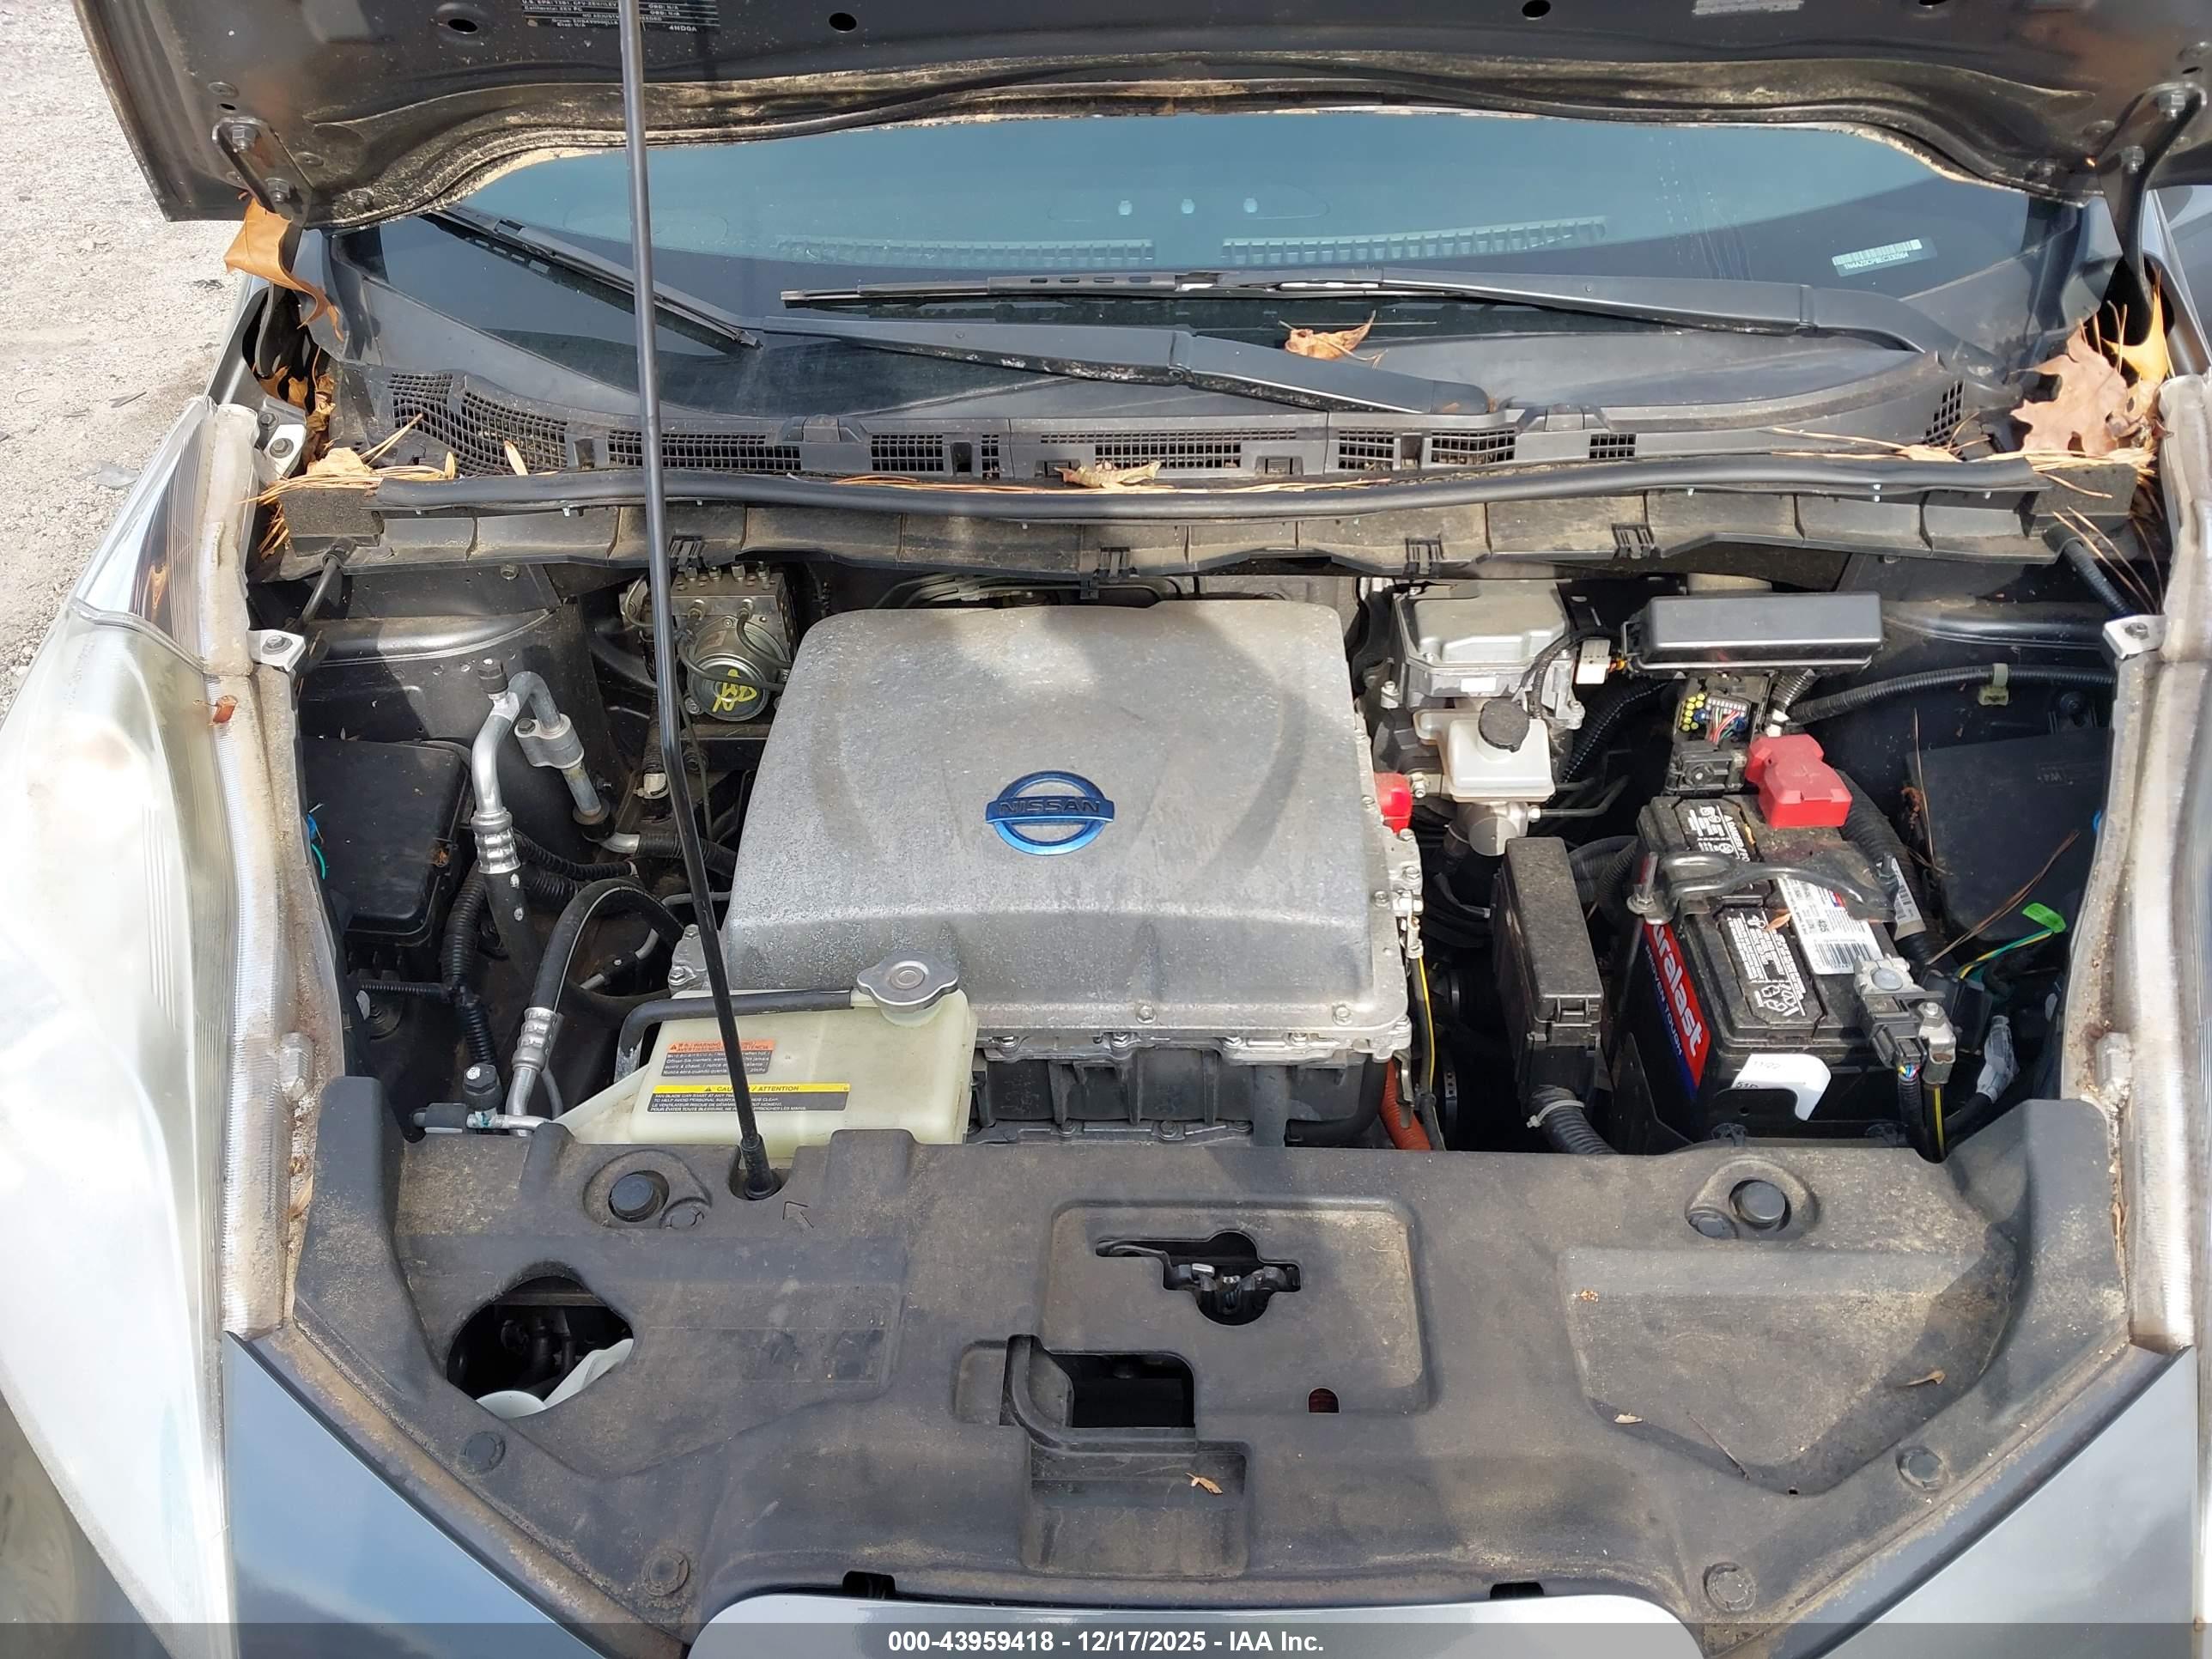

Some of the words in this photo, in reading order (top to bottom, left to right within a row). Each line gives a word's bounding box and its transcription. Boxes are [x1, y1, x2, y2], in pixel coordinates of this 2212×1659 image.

[1000, 799, 1100, 813] NISSAN
[1645, 945, 1666, 1003] PROVEN
[1665, 1004, 1682, 1056] TOUGH
[1652, 924, 1703, 1058] uralast
